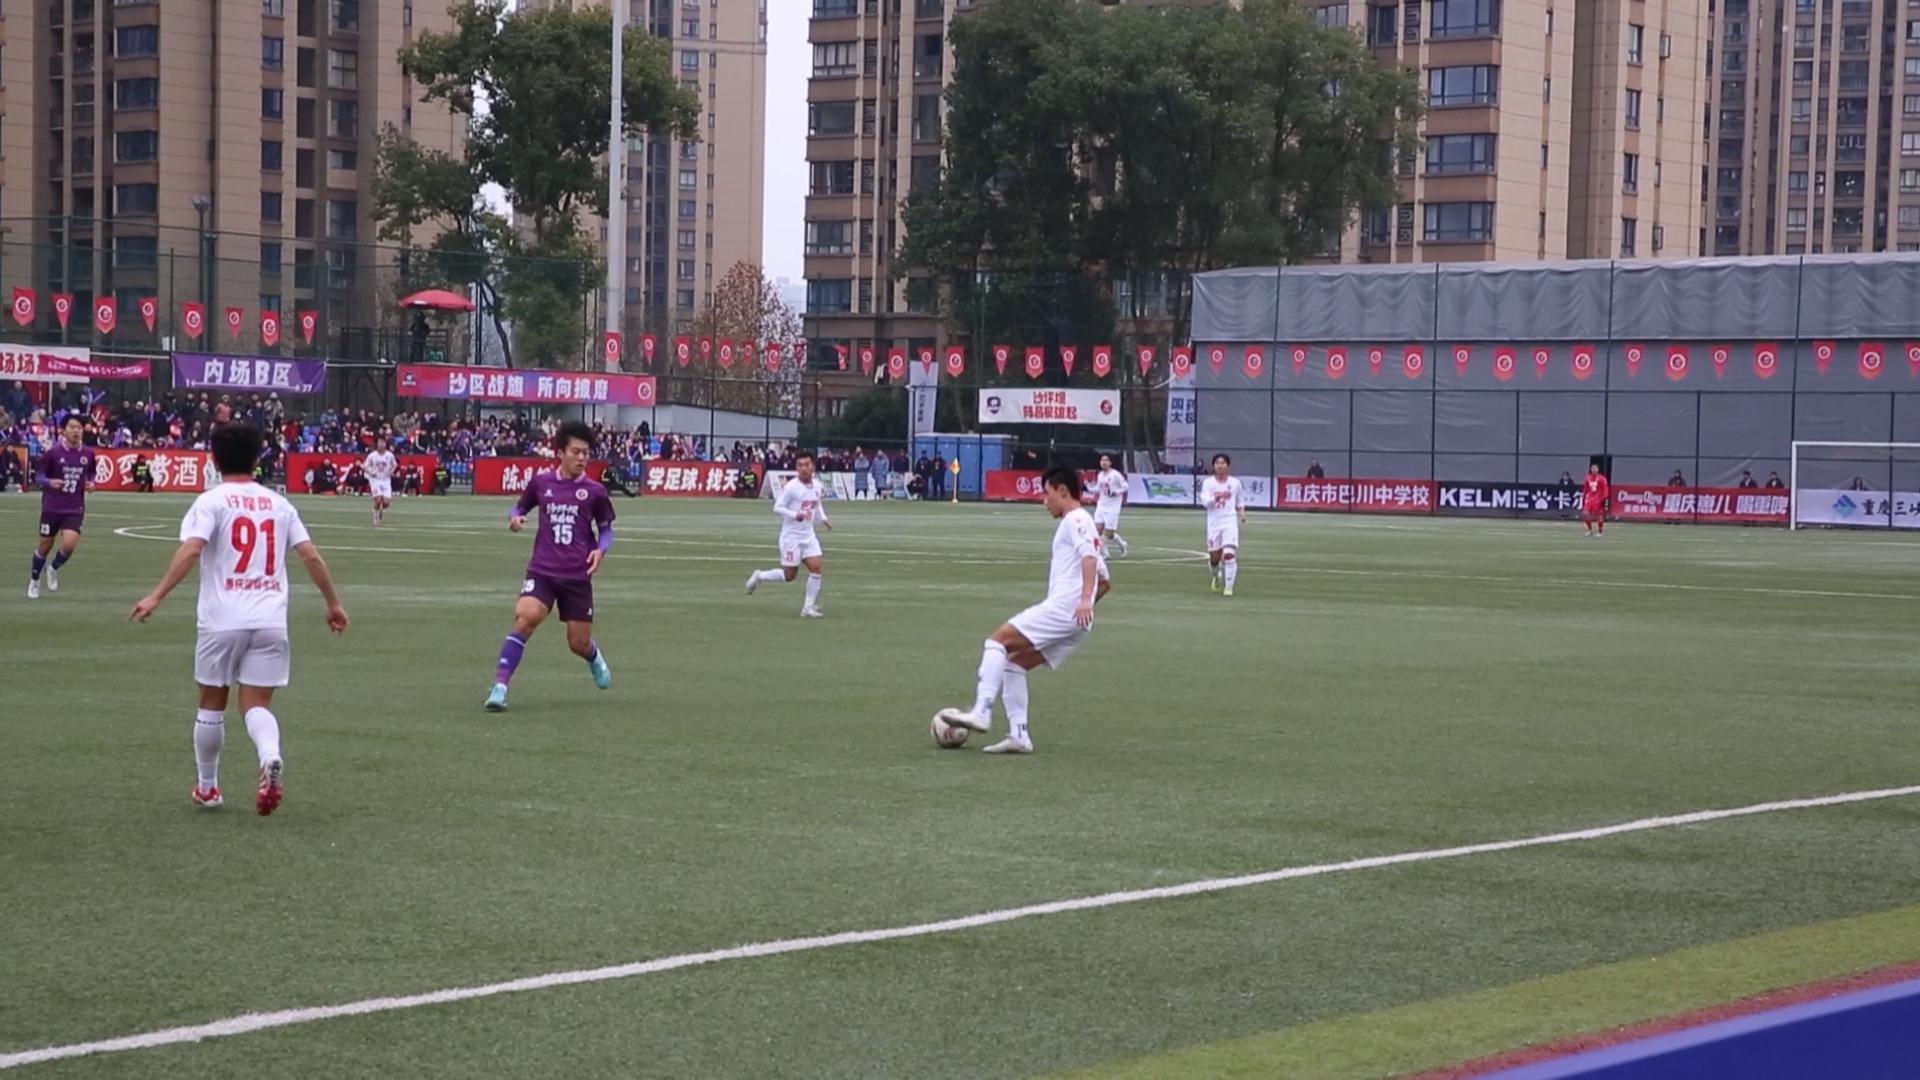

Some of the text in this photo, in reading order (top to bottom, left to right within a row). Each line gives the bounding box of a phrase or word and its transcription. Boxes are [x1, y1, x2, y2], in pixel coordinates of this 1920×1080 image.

[0, 352, 40, 374] 场场
[203, 358, 292, 386] 内场B区
[449, 372, 608, 400] 沙区战旗 所向披靡
[62, 480, 77, 493] 23
[647, 467, 745, 491] 学足球，找天
[1285, 483, 1429, 506] 重庆市巴川中学校
[1440, 487, 1529, 508] KELME
[231, 515, 275, 576] 91
[552, 524, 573, 545] 15
